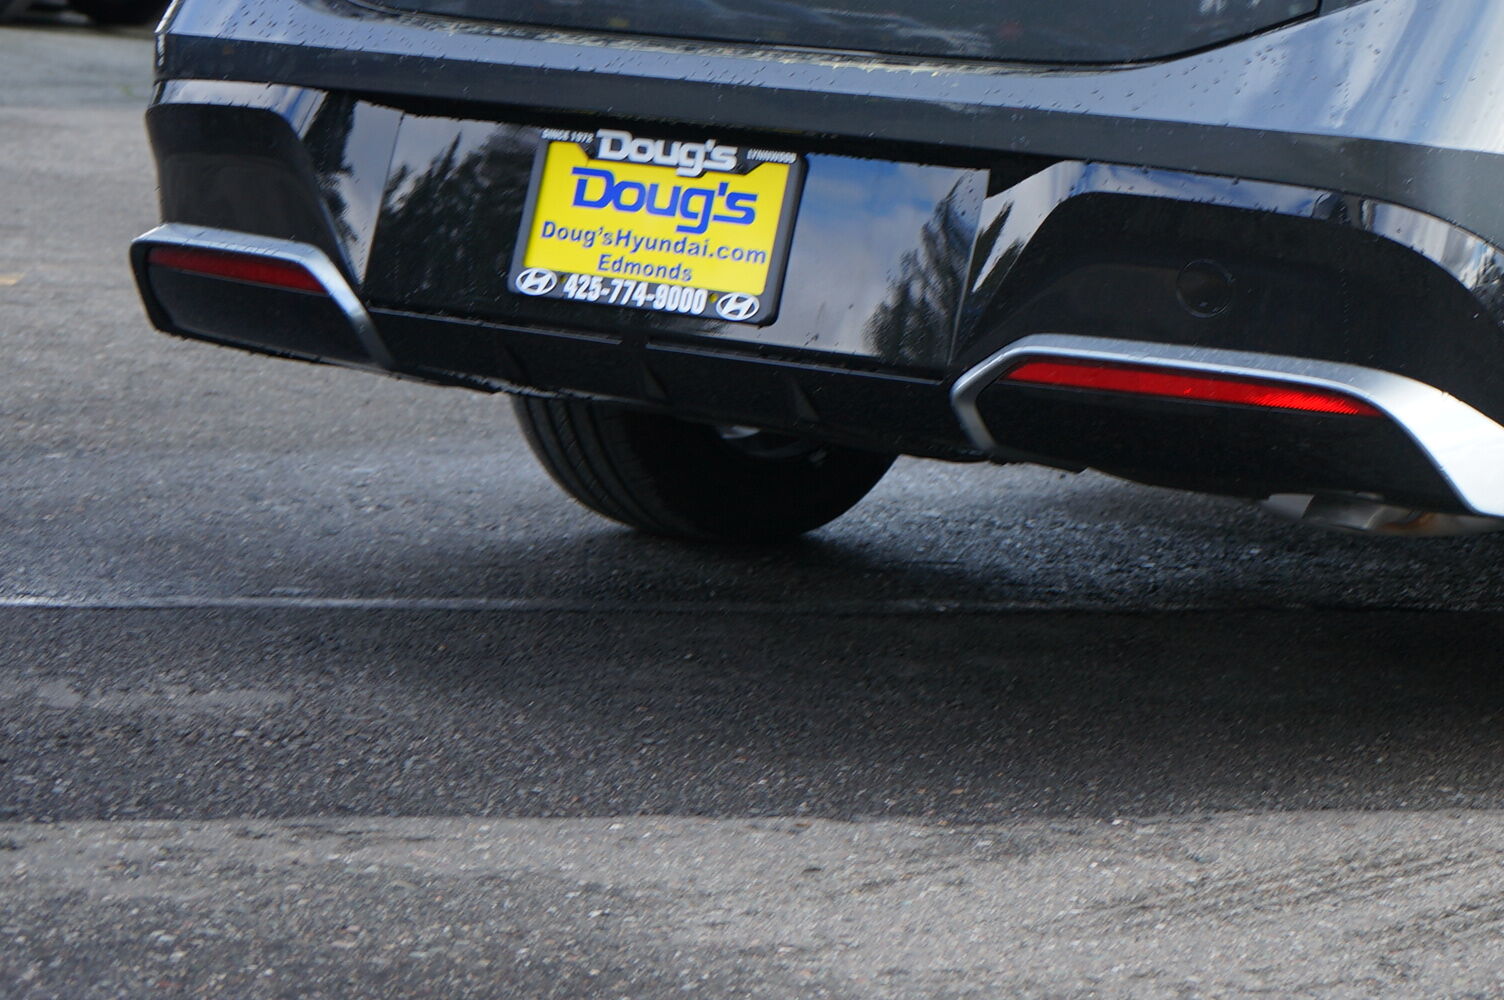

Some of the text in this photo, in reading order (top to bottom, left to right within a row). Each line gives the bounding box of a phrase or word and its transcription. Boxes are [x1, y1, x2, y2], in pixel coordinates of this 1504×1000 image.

[596, 128, 738, 177] Doug's
[570, 166, 758, 235] Doug's
[541, 220, 766, 264] Doug'sHyundai.com
[597, 254, 693, 282] Edmonds
[562, 273, 710, 315] 425-774-9000
